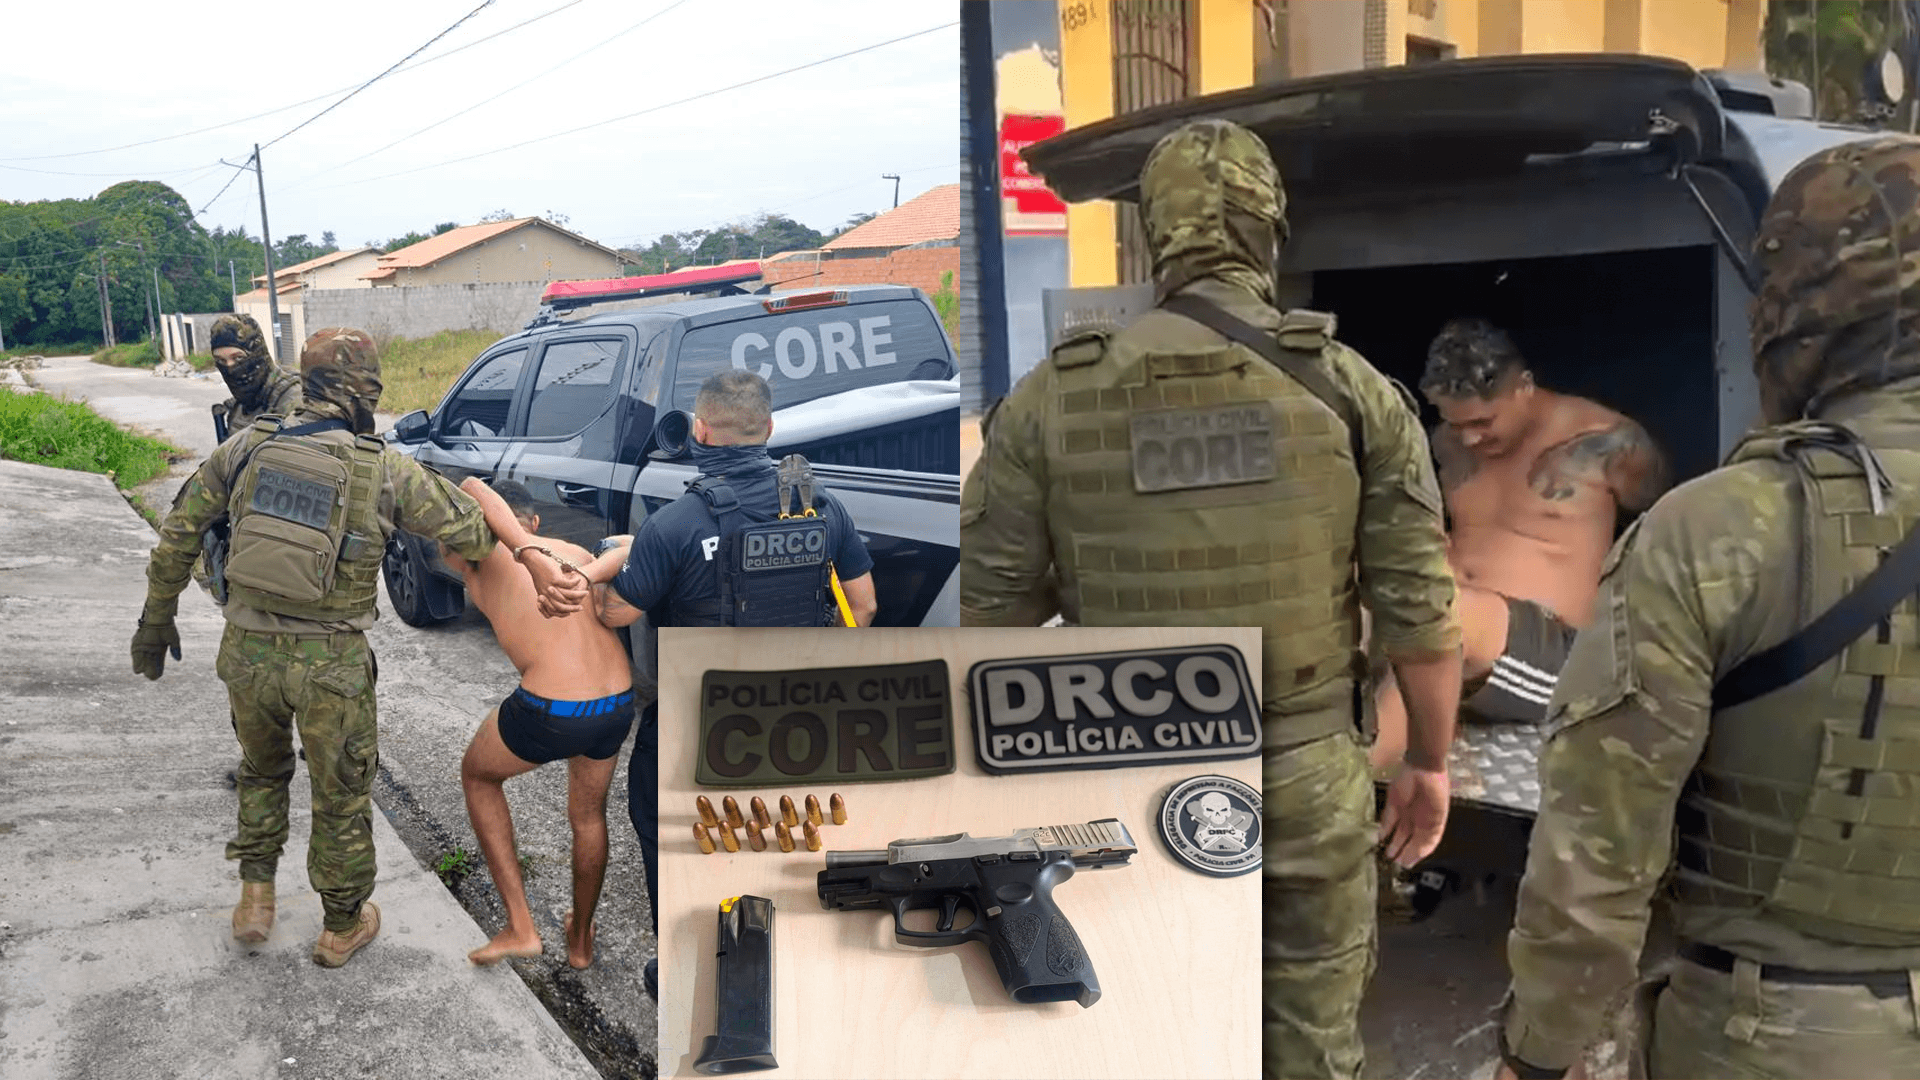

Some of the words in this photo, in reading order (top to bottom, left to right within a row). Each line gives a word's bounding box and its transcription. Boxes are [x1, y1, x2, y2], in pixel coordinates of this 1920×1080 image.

[731, 315, 897, 382] CORE
[1136, 430, 1270, 486] CORE
[254, 484, 330, 525] CORE
[748, 530, 823, 556] DRCO
[793, 553, 823, 563] CIVIL
[708, 678, 848, 707] POLÍCIA
[857, 674, 943, 702] CIVIL
[985, 655, 1240, 727] DRCO
[706, 704, 946, 777] CORE
[992, 724, 1144, 758] POLÍCIA
[1153, 720, 1254, 747] CIVIL
